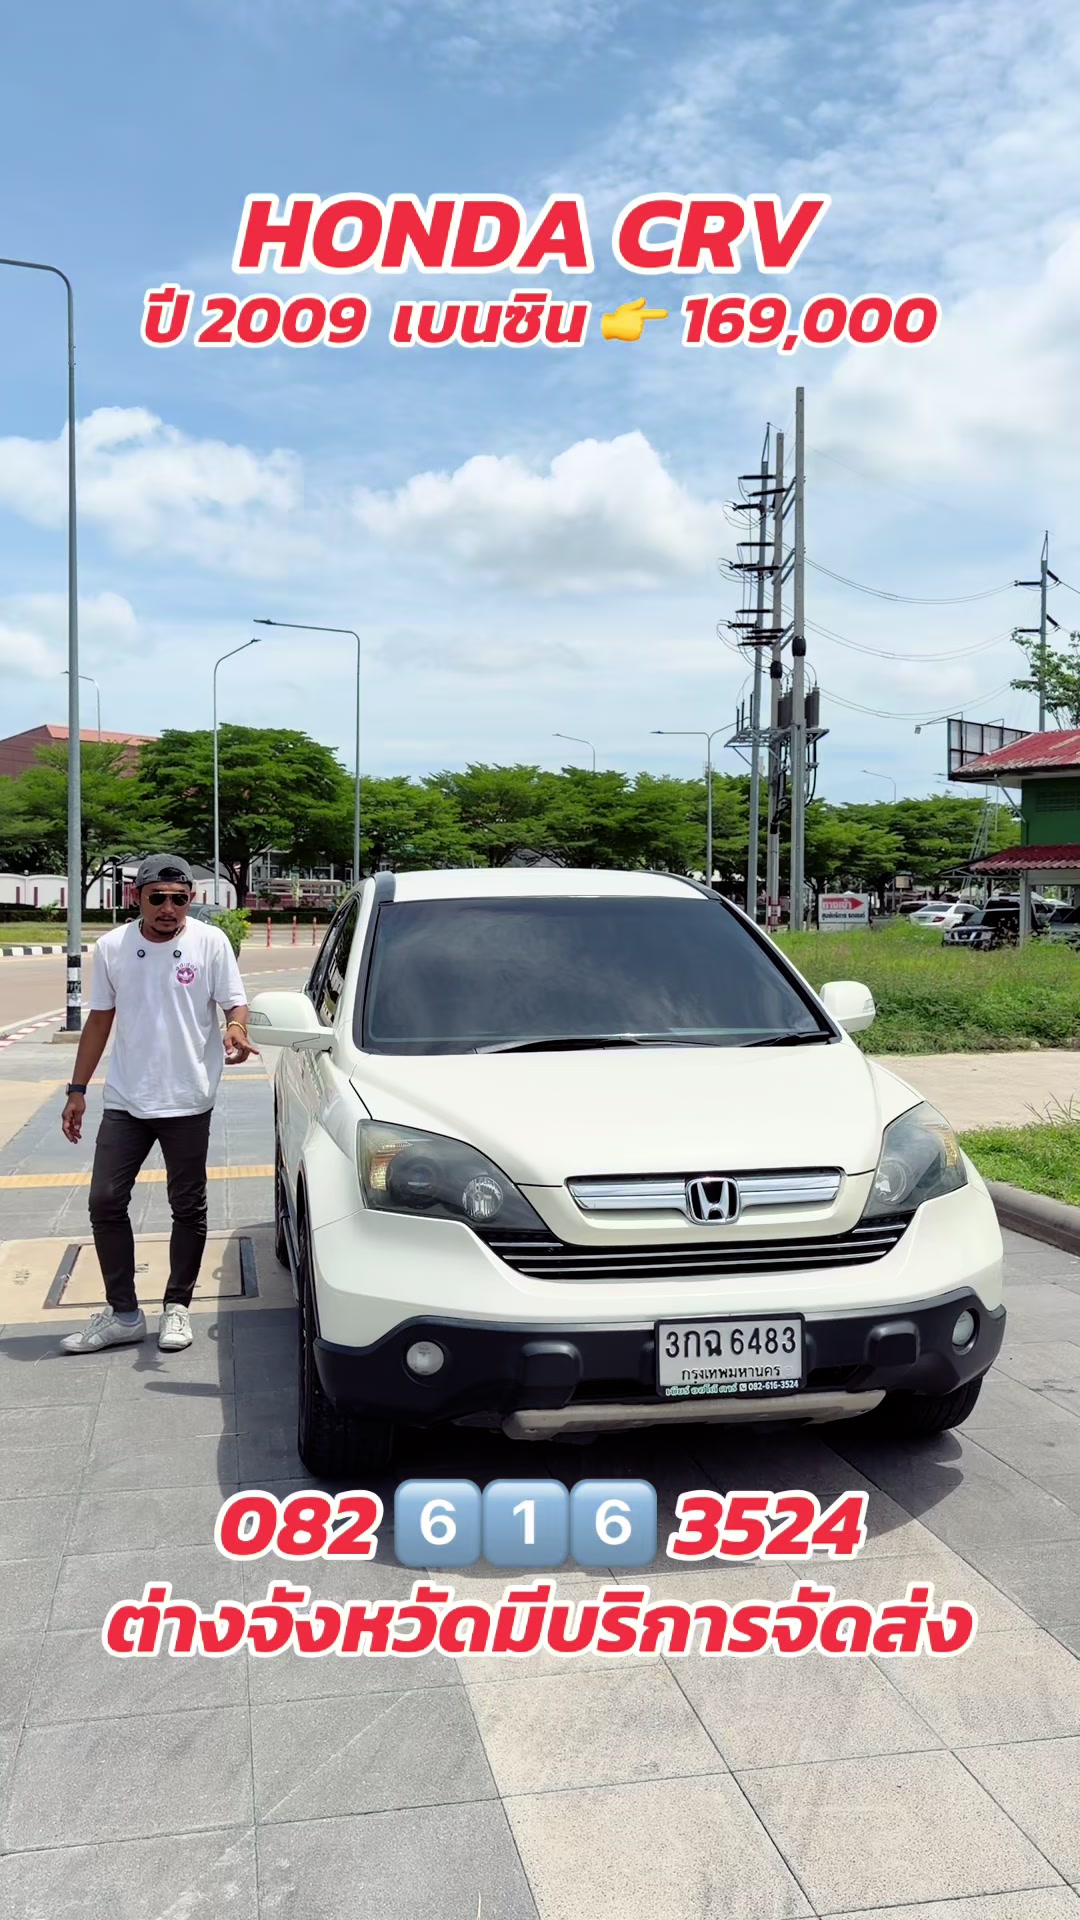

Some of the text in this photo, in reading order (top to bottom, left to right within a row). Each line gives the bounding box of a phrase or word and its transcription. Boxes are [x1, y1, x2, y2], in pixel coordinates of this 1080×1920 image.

[822, 898, 852, 909] ทางเข้า
[665, 1326, 796, 1358] 3กฉ 6483
[681, 1365, 781, 1384] กรุงเทพมหานคร
[748, 1380, 799, 1391] 082-616-3524
